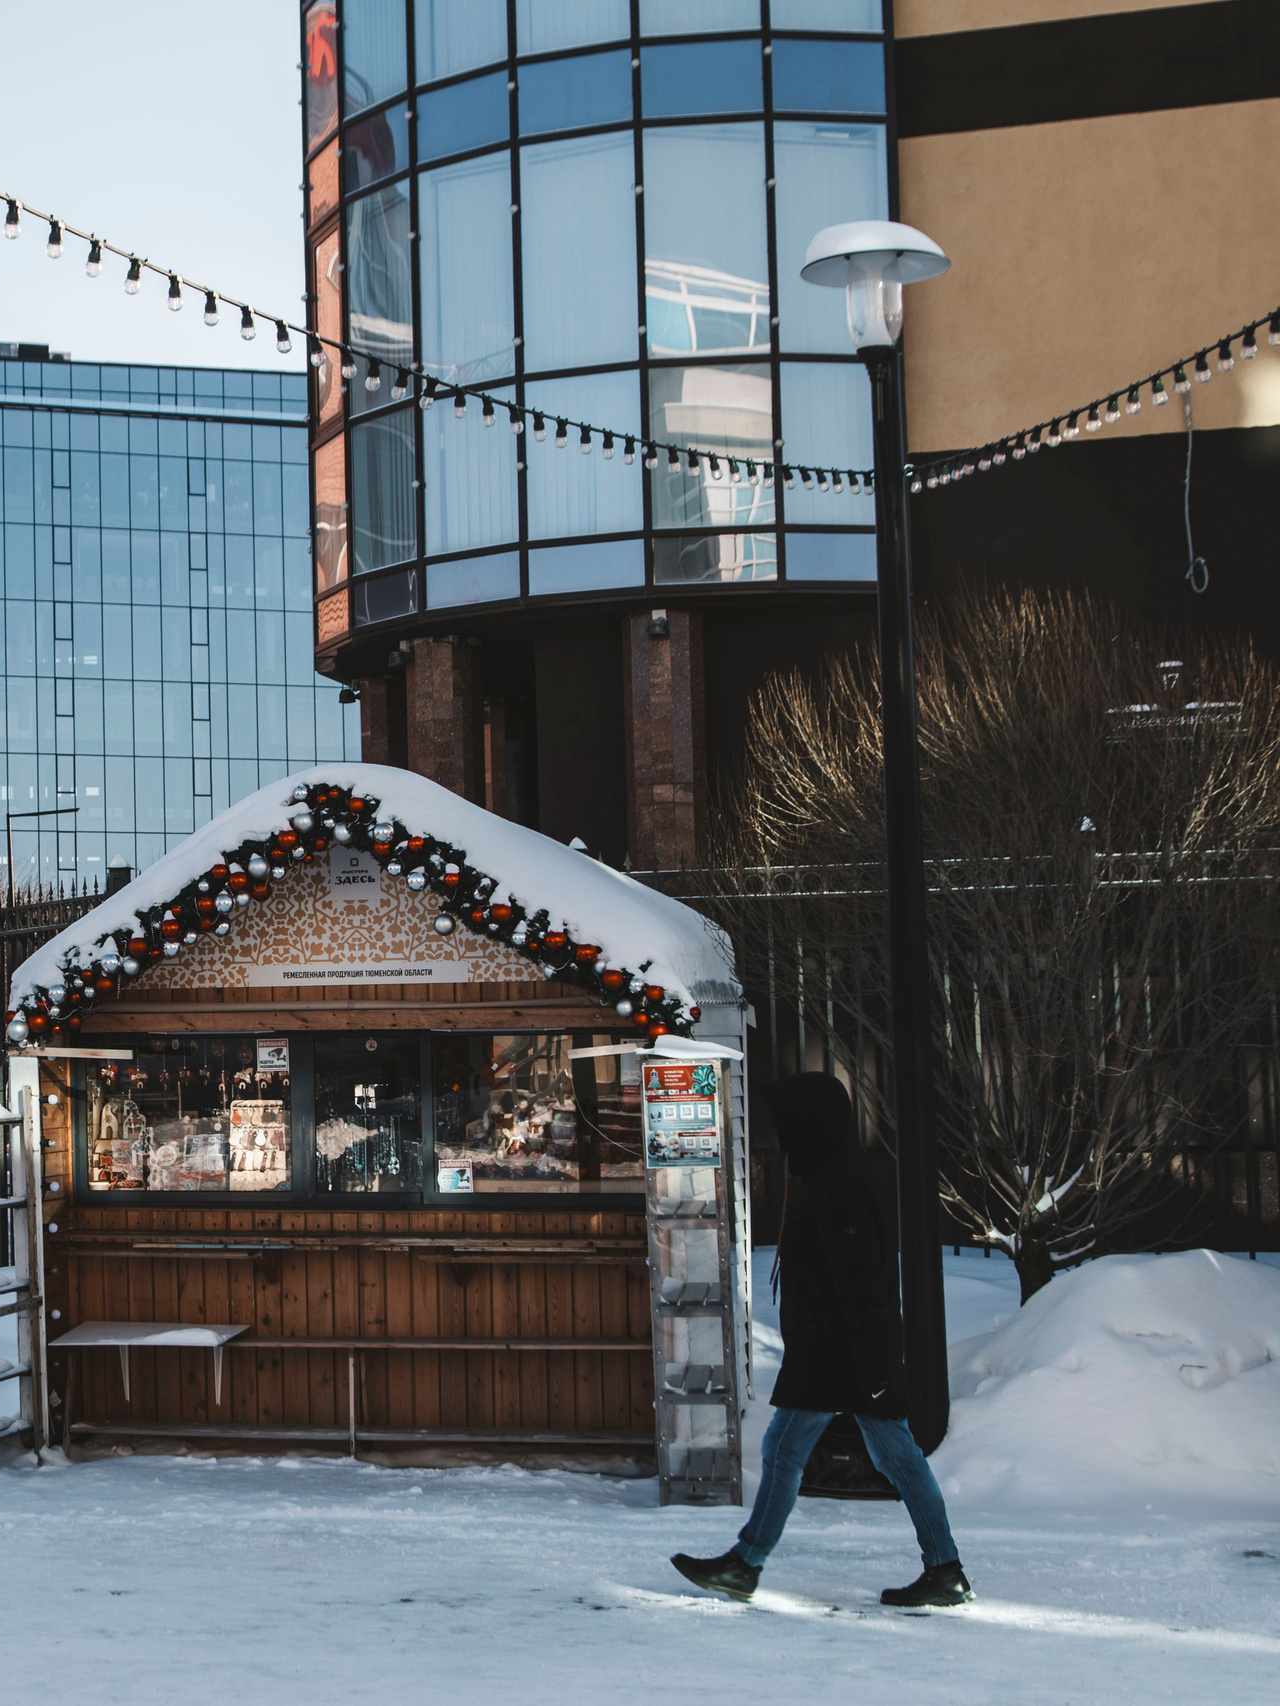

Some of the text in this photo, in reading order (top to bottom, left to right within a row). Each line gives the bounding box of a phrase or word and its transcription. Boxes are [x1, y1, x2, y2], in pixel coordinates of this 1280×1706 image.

[1162, 672, 1179, 690] 17
[334, 875, 376, 885] ЗДЕСЬ
[282, 968, 433, 979] РЕМЕСЛЕННАЯ ПРОДУКЦИЯ ТЮМЕНСКОЙ ОБЛАСТИ
